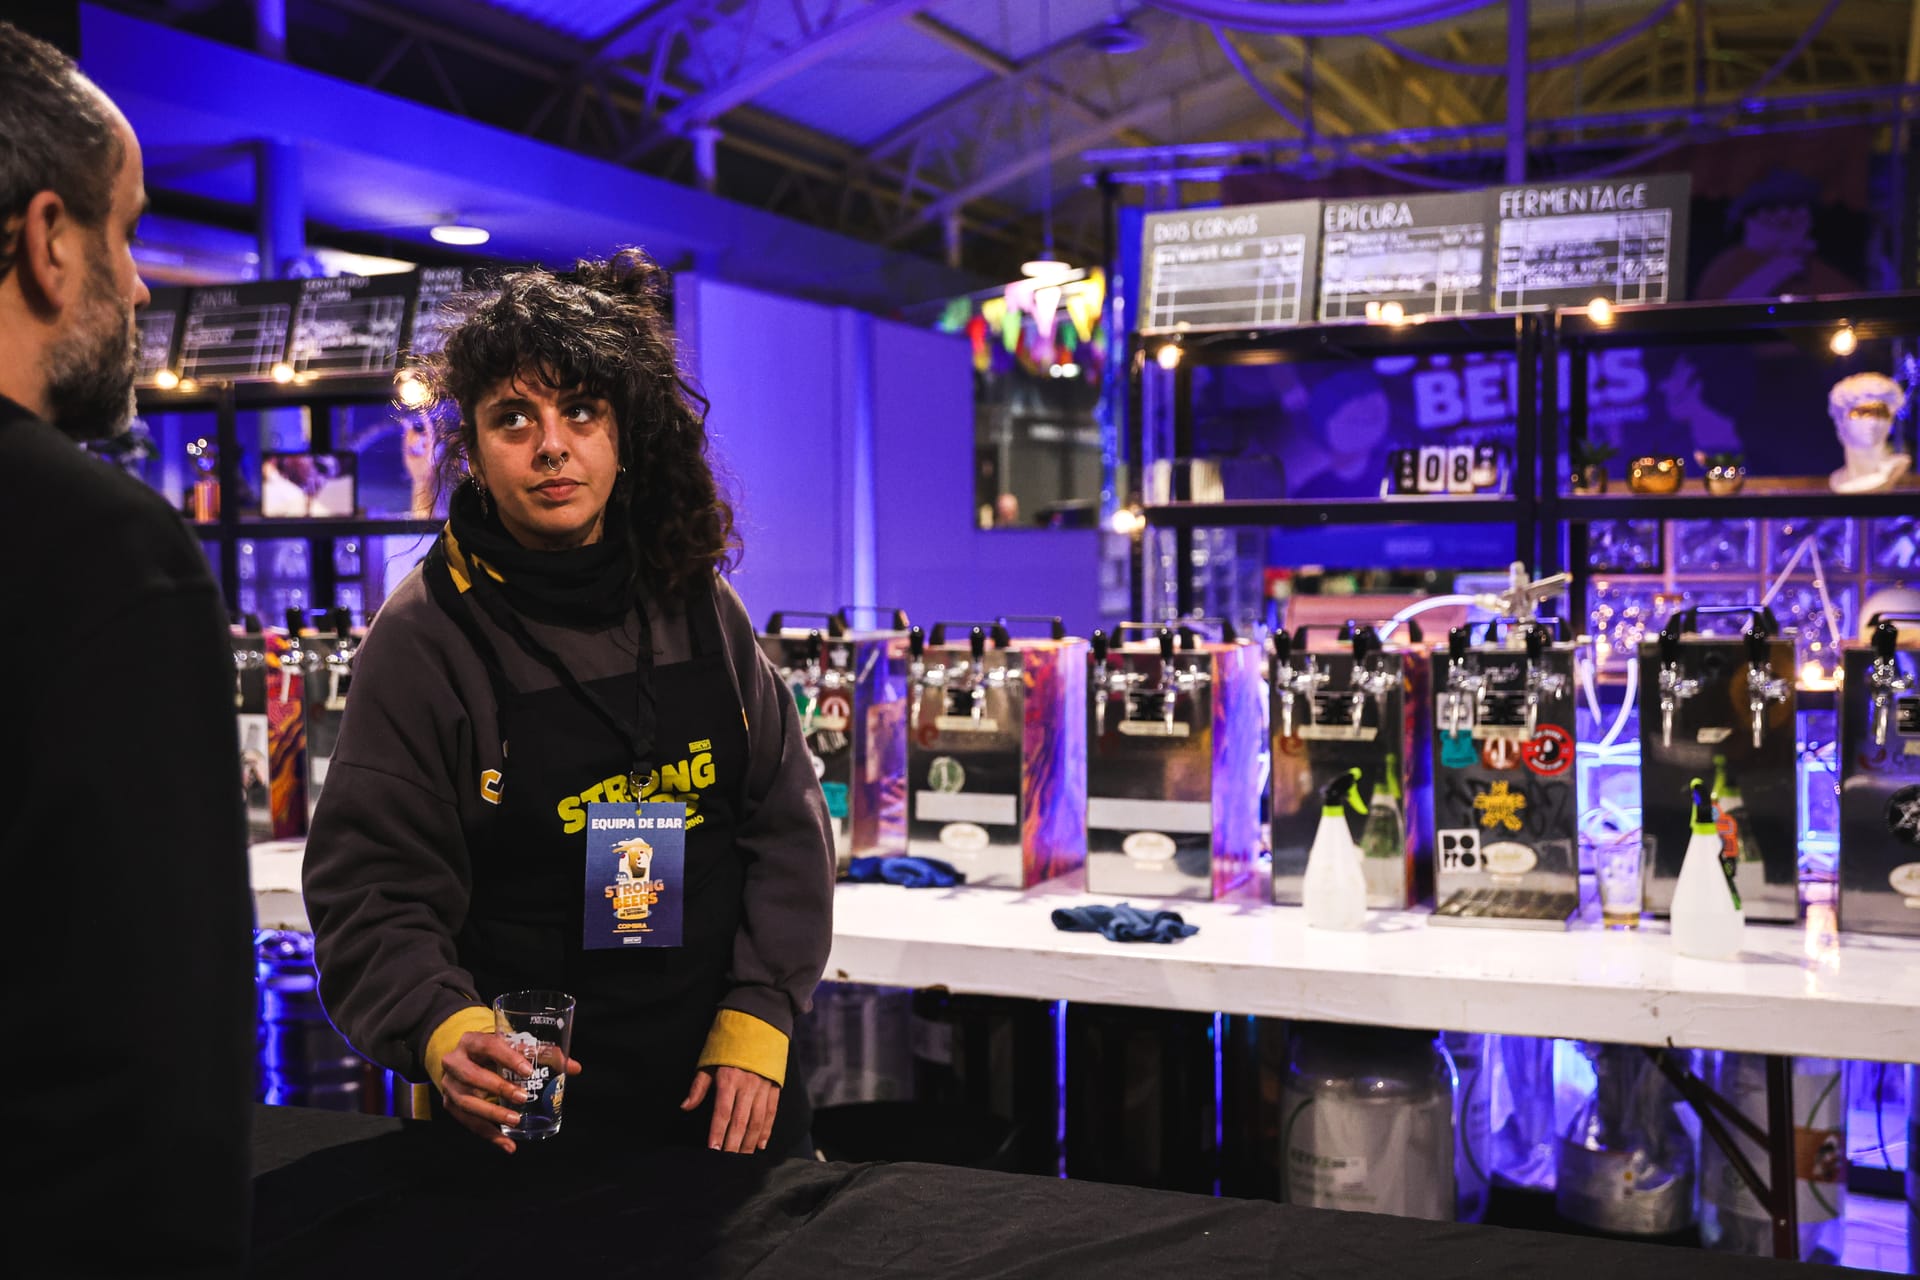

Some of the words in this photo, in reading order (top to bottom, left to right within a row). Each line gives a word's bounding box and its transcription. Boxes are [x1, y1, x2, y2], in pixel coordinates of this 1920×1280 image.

[1499, 182, 1648, 218] FERMENTAGE
[591, 818, 635, 831] EQUIPA
[638, 818, 654, 829] DE
[657, 818, 682, 829] BAR
[604, 879, 665, 898] STRONG
[612, 892, 658, 910] BEERS
[502, 1066, 549, 1081] STNG
